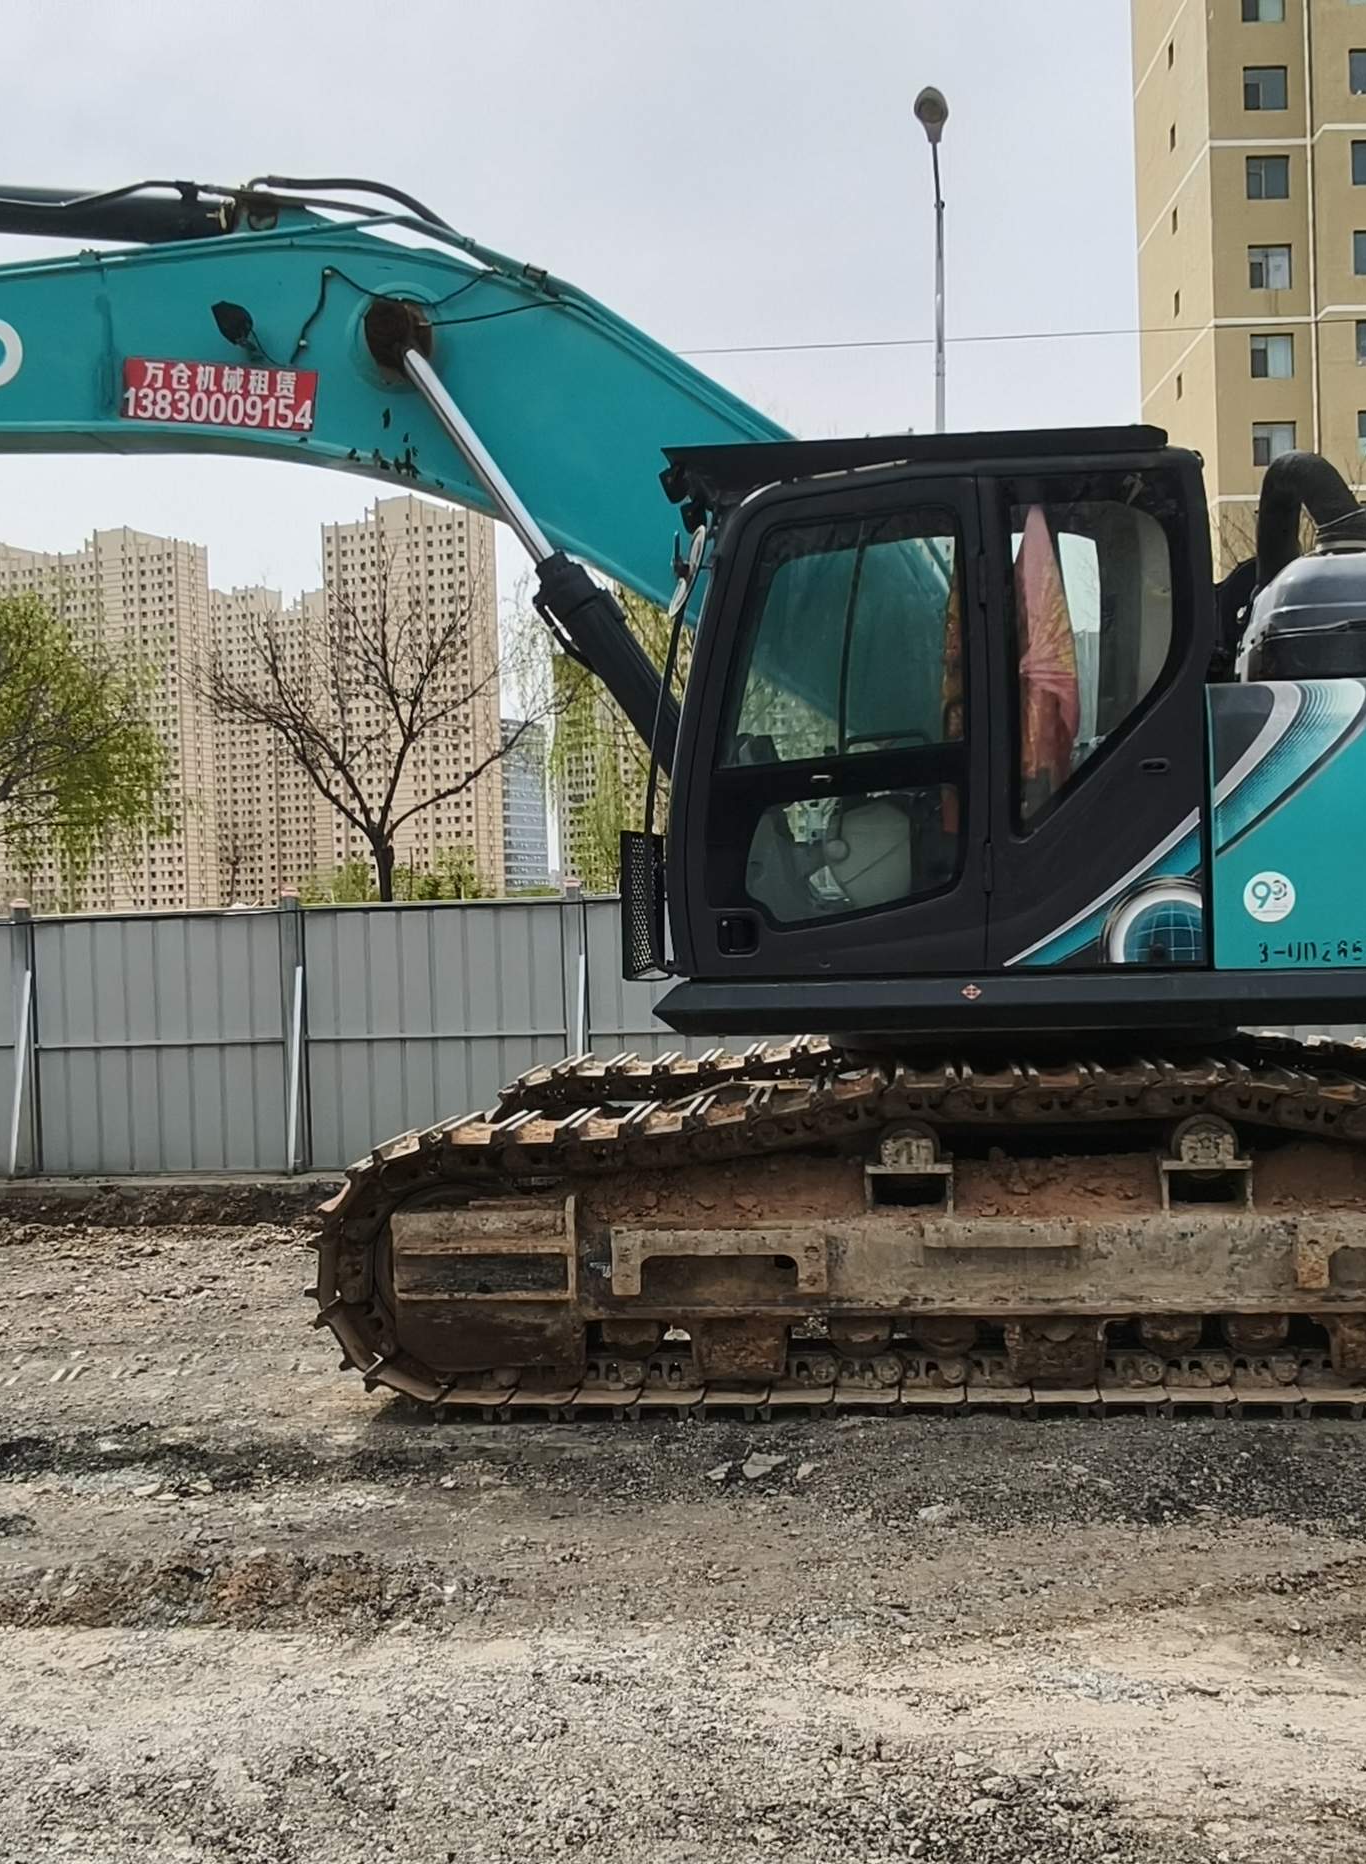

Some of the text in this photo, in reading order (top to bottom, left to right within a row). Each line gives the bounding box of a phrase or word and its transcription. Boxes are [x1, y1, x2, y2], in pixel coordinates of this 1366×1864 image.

[143, 361, 297, 399] 万仓机械租赁
[123, 386, 313, 431] 13830009154
